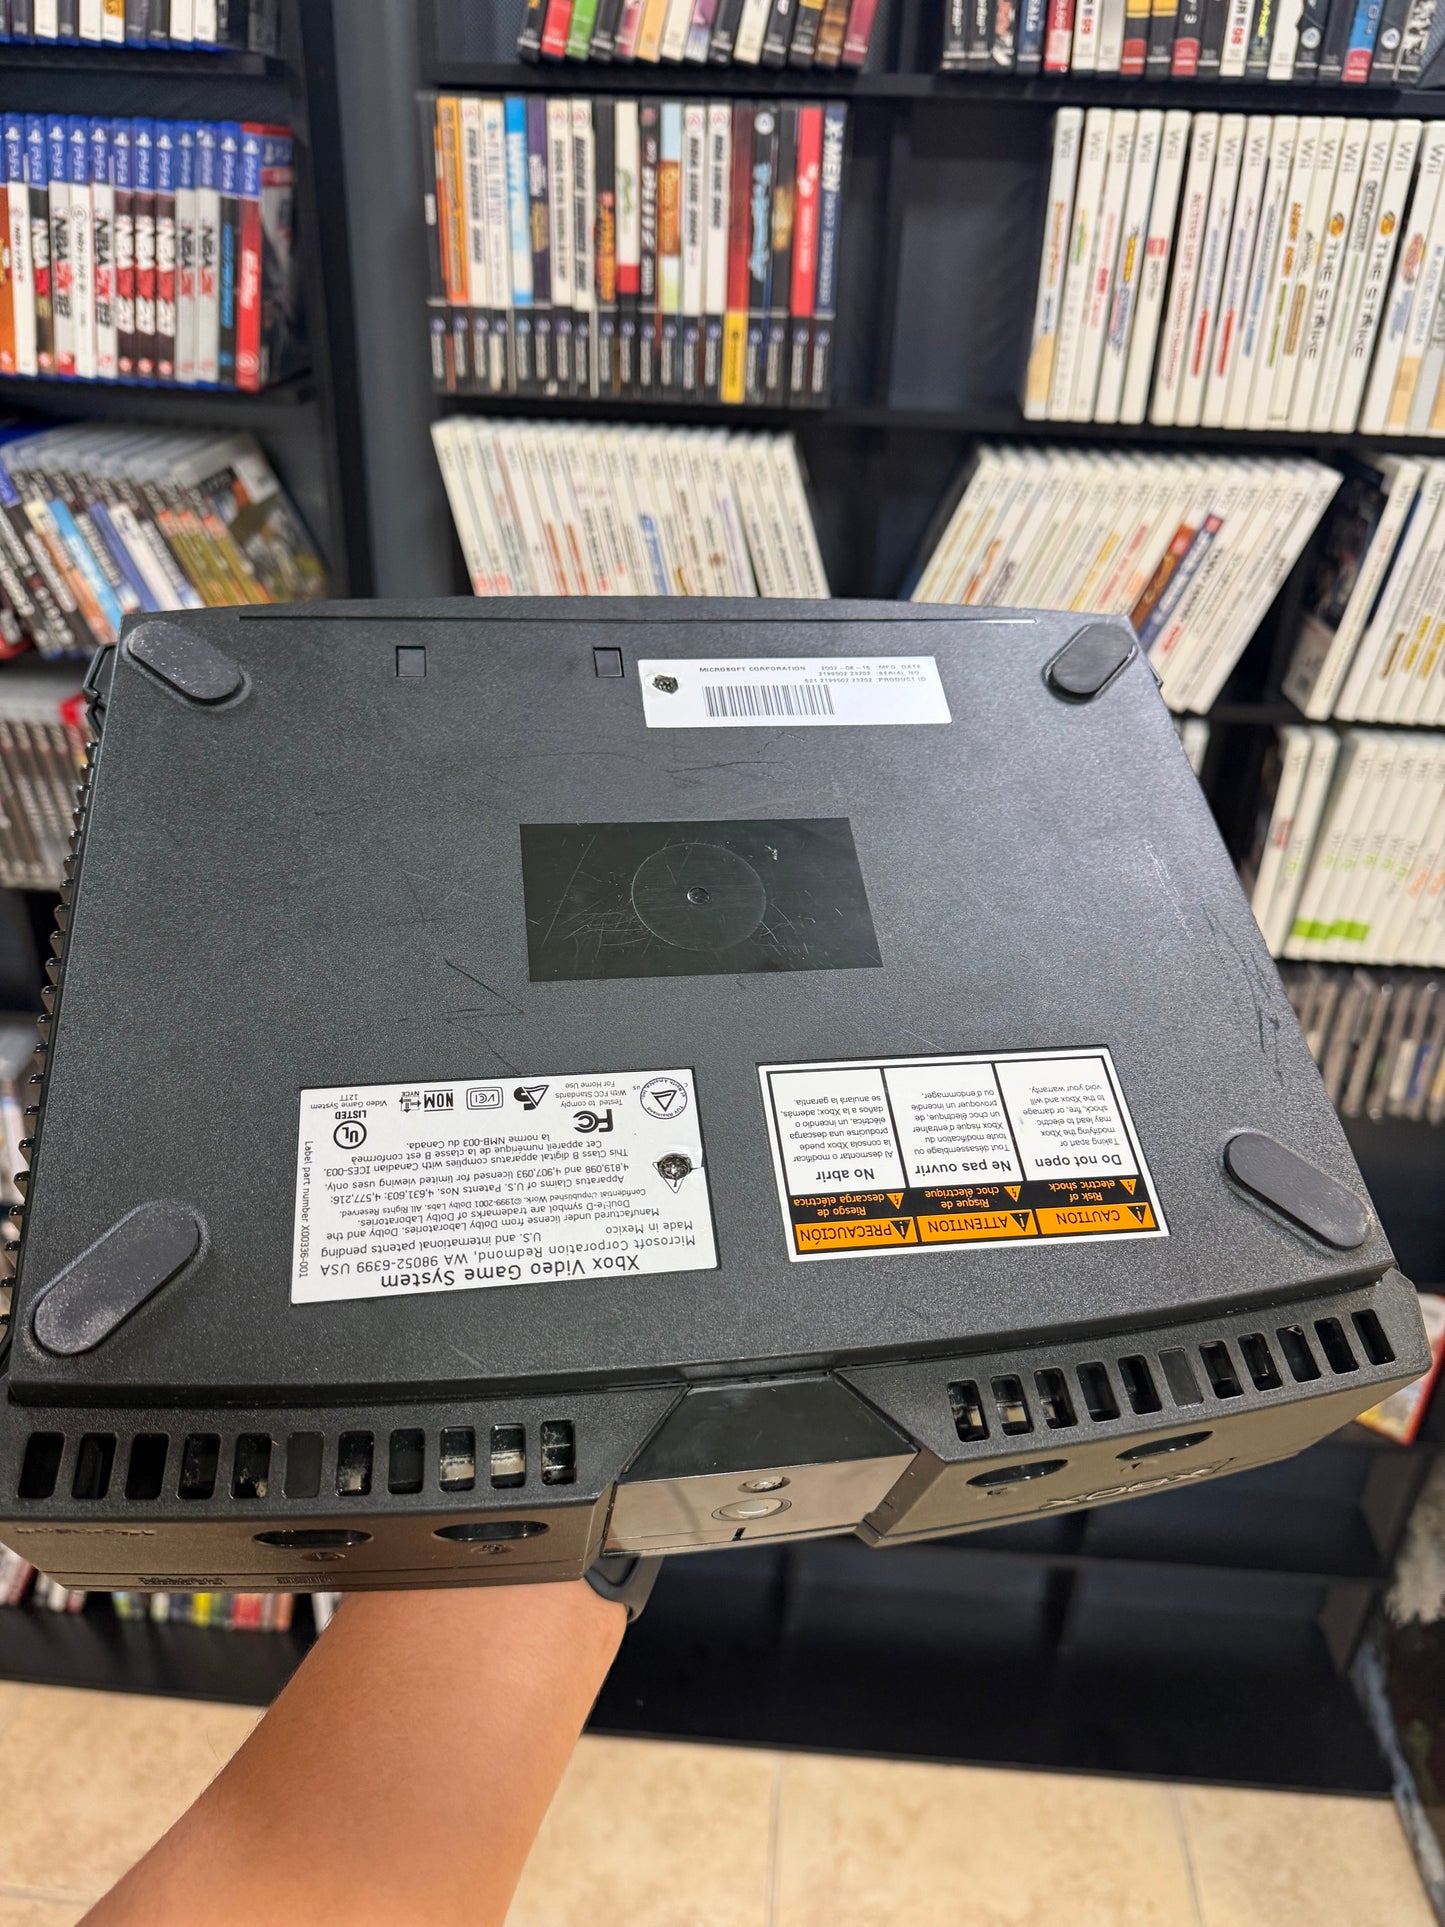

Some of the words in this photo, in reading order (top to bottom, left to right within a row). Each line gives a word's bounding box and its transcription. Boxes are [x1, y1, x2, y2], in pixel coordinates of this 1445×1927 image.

[1029, 1086, 1066, 1095] warranty.
[1067, 1083, 1085, 1092] your
[1085, 1084, 1103, 1092] void
[424, 1092, 454, 1109] NOM
[335, 1110, 367, 1120] LISTED
[1040, 1130, 1063, 1138] Xbox
[1063, 1129, 1077, 1137] the
[1077, 1126, 1116, 1136] modifying
[463, 1137, 506, 1148] NMB-003
[508, 1135, 539, 1143] norme
[541, 1134, 551, 1142] la
[1069, 1138, 1091, 1148] apart
[1091, 1137, 1121, 1146] Taking
[406, 1141, 445, 1151] Canada.
[448, 1140, 461, 1149] du
[494, 1144, 544, 1155] numérique
[546, 1140, 584, 1152] appareil
[586, 1140, 603, 1149] Cet
[1060, 1140, 1069, 1148] or
[304, 1141, 314, 1166] Label
[406, 1152, 422, 1161] est
[435, 1149, 465, 1158] classe
[467, 1148, 477, 1157] la
[479, 1147, 492, 1156] de
[541, 1151, 570, 1163] digital
[582, 1150, 607, 1159] Class
[609, 1149, 629, 1158] This
[445, 1157, 488, 1169] complies
[490, 1153, 539, 1164] apparatus
[1035, 1155, 1071, 1168] open
[1073, 1156, 1098, 1168] not
[1101, 1154, 1123, 1166] Do
[373, 1162, 419, 1174] Canadian
[422, 1161, 444, 1171] with
[564, 1166, 583, 1176] and
[585, 1162, 630, 1175] 4,819,098
[915, 1163, 958, 1177] ouvrir
[962, 1159, 988, 1172] pas
[992, 1160, 1012, 1173] Ne
[302, 1167, 311, 1187] part
[323, 1166, 371, 1178] ICES-003.
[473, 1171, 514, 1183] licensed
[516, 1167, 562, 1179] 4,907,093
[816, 1170, 850, 1183] abrir
[854, 1168, 875, 1181] No
[379, 1178, 417, 1189] viewing
[419, 1175, 454, 1187] limited
[456, 1174, 471, 1183] for
[540, 1179, 573, 1189] Claims
[575, 1174, 625, 1186] Apparatus
[325, 1182, 349, 1193] only.
[352, 1181, 376, 1190] uses
[463, 1184, 502, 1194] Patents
[505, 1182, 525, 1192] U.S.
[527, 1181, 538, 1191] of
[1048, 1182, 1078, 1193] shock
[1080, 1180, 1116, 1190] electric
[437, 1187, 460, 1197] Nos.
[600, 1189, 647, 1199] Confidential
[925, 1188, 974, 1199] électrique
[976, 1187, 1000, 1196] choc
[1081, 1192, 1104, 1202] Risk
[524, 1196, 548, 1205] Work.
[793, 1197, 837, 1208] eléctrica
[839, 1194, 885, 1204] descarga
[956, 1198, 990, 1209] Risque
[1069, 1193, 1080, 1203] of
[301, 1188, 312, 1223] number
[382, 1205, 409, 1215] Rights
[411, 1205, 423, 1214] All
[424, 1203, 447, 1212] Labs.
[448, 1201, 472, 1210] Dolby
[530, 1206, 547, 1214] are
[549, 1202, 584, 1214] symbol
[833, 1205, 867, 1217] Riesgo
[940, 1201, 954, 1210] de
[339, 1208, 380, 1219] Reserved.
[426, 1212, 455, 1223] Dolby
[457, 1212, 468, 1222] of
[471, 1207, 528, 1220] trademarks
[563, 1213, 592, 1223] under
[594, 1208, 660, 1221] Manufactured
[817, 1209, 830, 1219] de
[1056, 1210, 1121, 1226] CAUTION
[358, 1215, 424, 1228] Laboratories.
[469, 1220, 498, 1231] Dolby
[501, 1218, 525, 1227] from
[527, 1215, 561, 1225] license
[928, 1216, 1008, 1234] ATTENTION
[402, 1222, 467, 1236] Laboratories.
[605, 1224, 645, 1236] Mexico
[648, 1223, 660, 1233] in
[663, 1220, 694, 1232] Made
[326, 1232, 344, 1242] the
[347, 1230, 367, 1241] and
[369, 1228, 399, 1239] Dolby
[520, 1232, 542, 1244] U.S.
[800, 1224, 893, 1246] PRECAUCIÓN
[419, 1236, 492, 1252] international
[495, 1234, 517, 1246] and
[634, 1235, 696, 1251] Microsoft
[299, 1225, 311, 1279] X00336-001
[321, 1244, 368, 1259] pending
[371, 1240, 416, 1255] patents
[549, 1240, 629, 1256] Corporation
[444, 1253, 469, 1266] WA
[474, 1247, 543, 1264] Redmond,
[356, 1255, 439, 1274] 98052-6399
[531, 1259, 586, 1278] Video
[592, 1255, 640, 1272] Xbox
[320, 1263, 351, 1277] USA
[464, 1265, 522, 1281] Game
[381, 1269, 456, 1288] System
